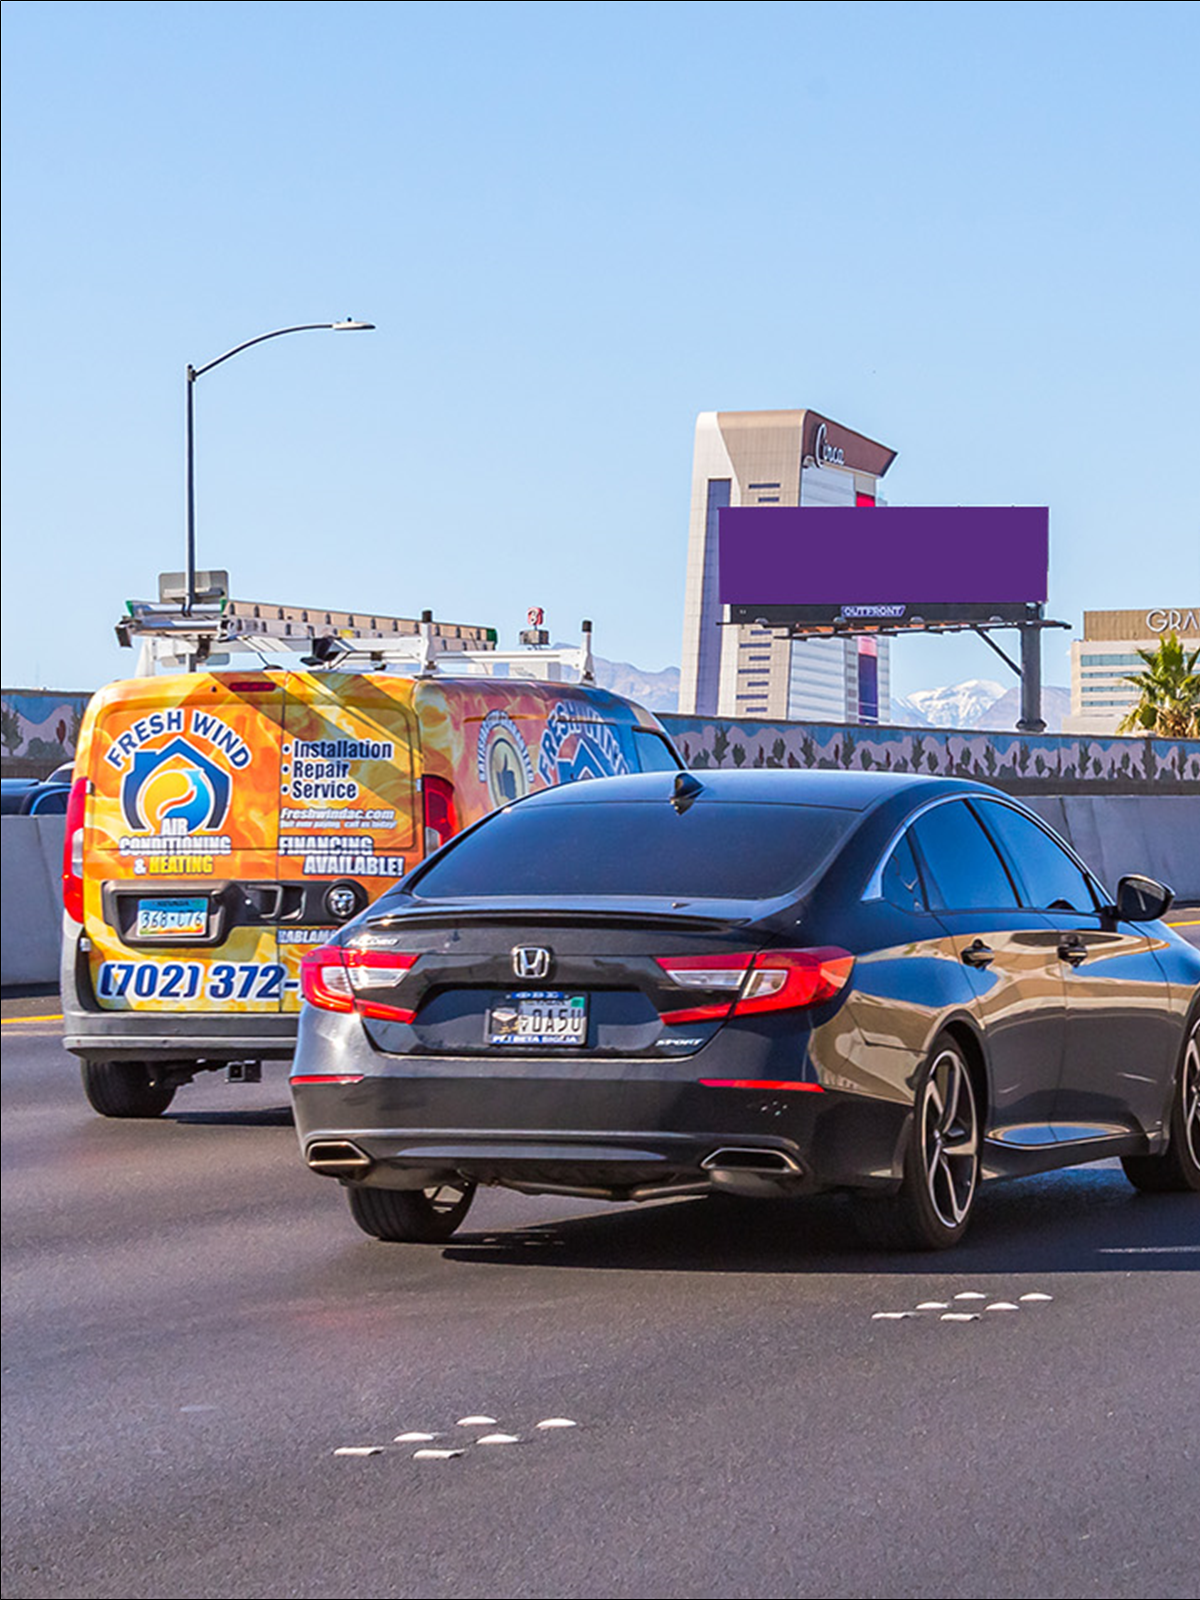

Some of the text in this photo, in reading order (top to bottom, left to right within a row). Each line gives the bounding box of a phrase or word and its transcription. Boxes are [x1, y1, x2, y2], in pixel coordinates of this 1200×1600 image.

[815, 423, 845, 467] Circa
[843, 606, 903, 616] OUTFRONT
[107, 711, 250, 768] FRESH WIND
[293, 740, 393, 759] Installation
[292, 760, 350, 780] Repair
[291, 779, 358, 800] Service
[161, 818, 188, 836] AIR
[119, 836, 231, 856] CONDITIONING
[278, 835, 374, 856] FINANCING
[133, 856, 213, 874] & HEATING
[303, 855, 405, 876] AVAILABLE!
[99, 964, 306, 999] (702) 372-
[655, 1038, 703, 1047] SPORT
